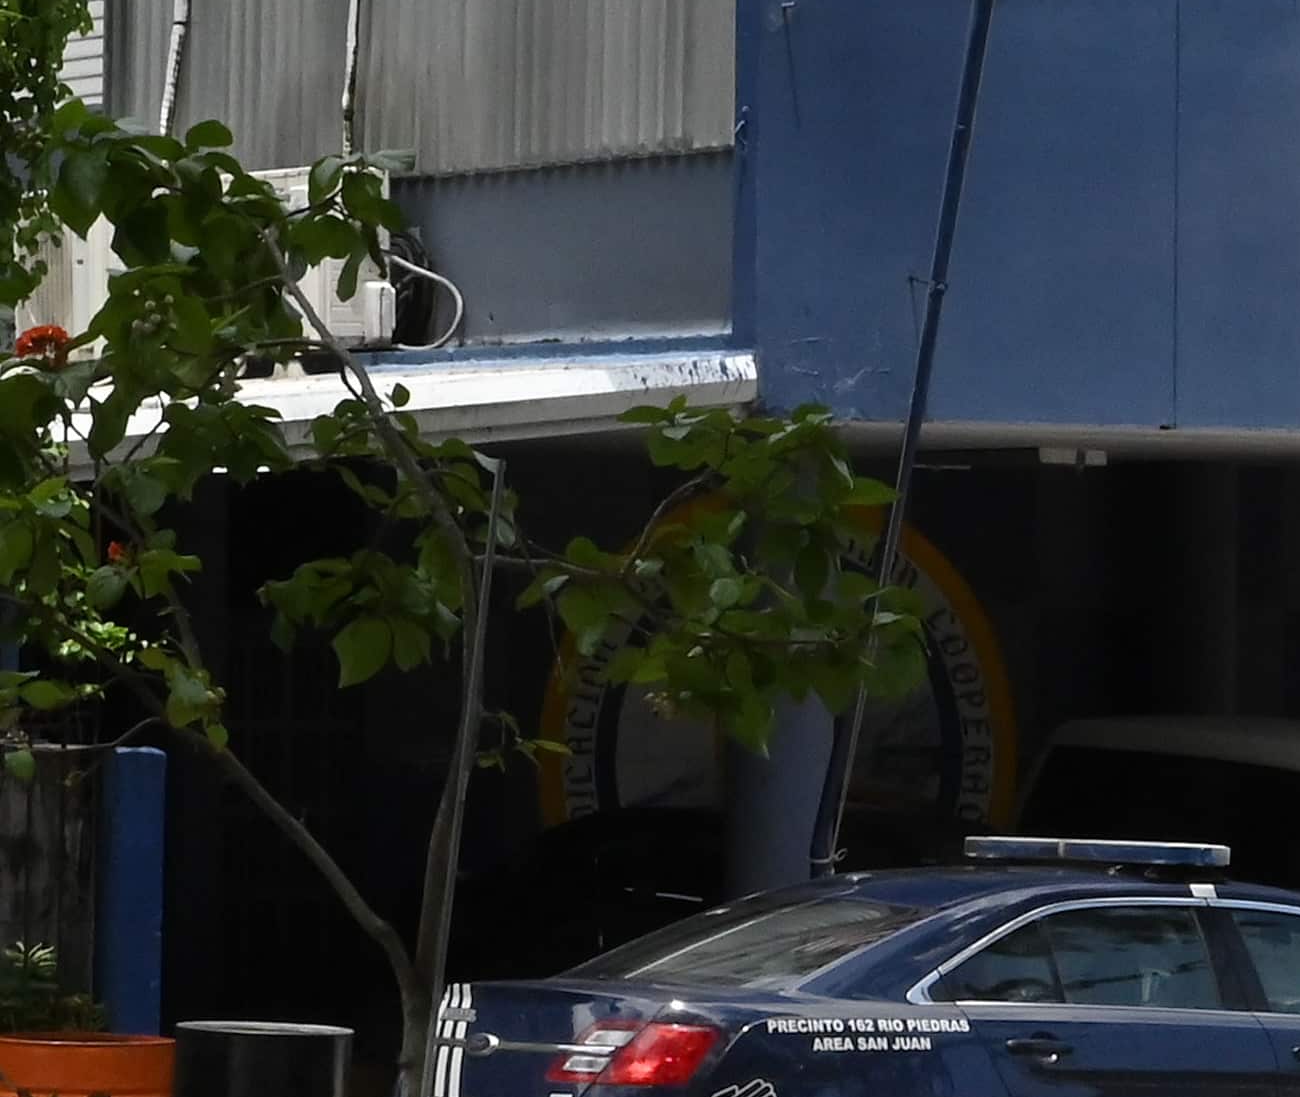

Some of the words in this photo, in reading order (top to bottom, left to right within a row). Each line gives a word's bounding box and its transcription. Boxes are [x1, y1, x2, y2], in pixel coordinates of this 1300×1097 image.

[767, 1018, 844, 1033] PRECINTO
[848, 1019, 875, 1032] 162
[877, 1018, 902, 1032] RIO
[907, 1018, 970, 1033] PIEDRAS
[813, 1036, 854, 1051] AREA
[857, 1036, 889, 1051] SAN
[891, 1036, 932, 1051] JUAN
